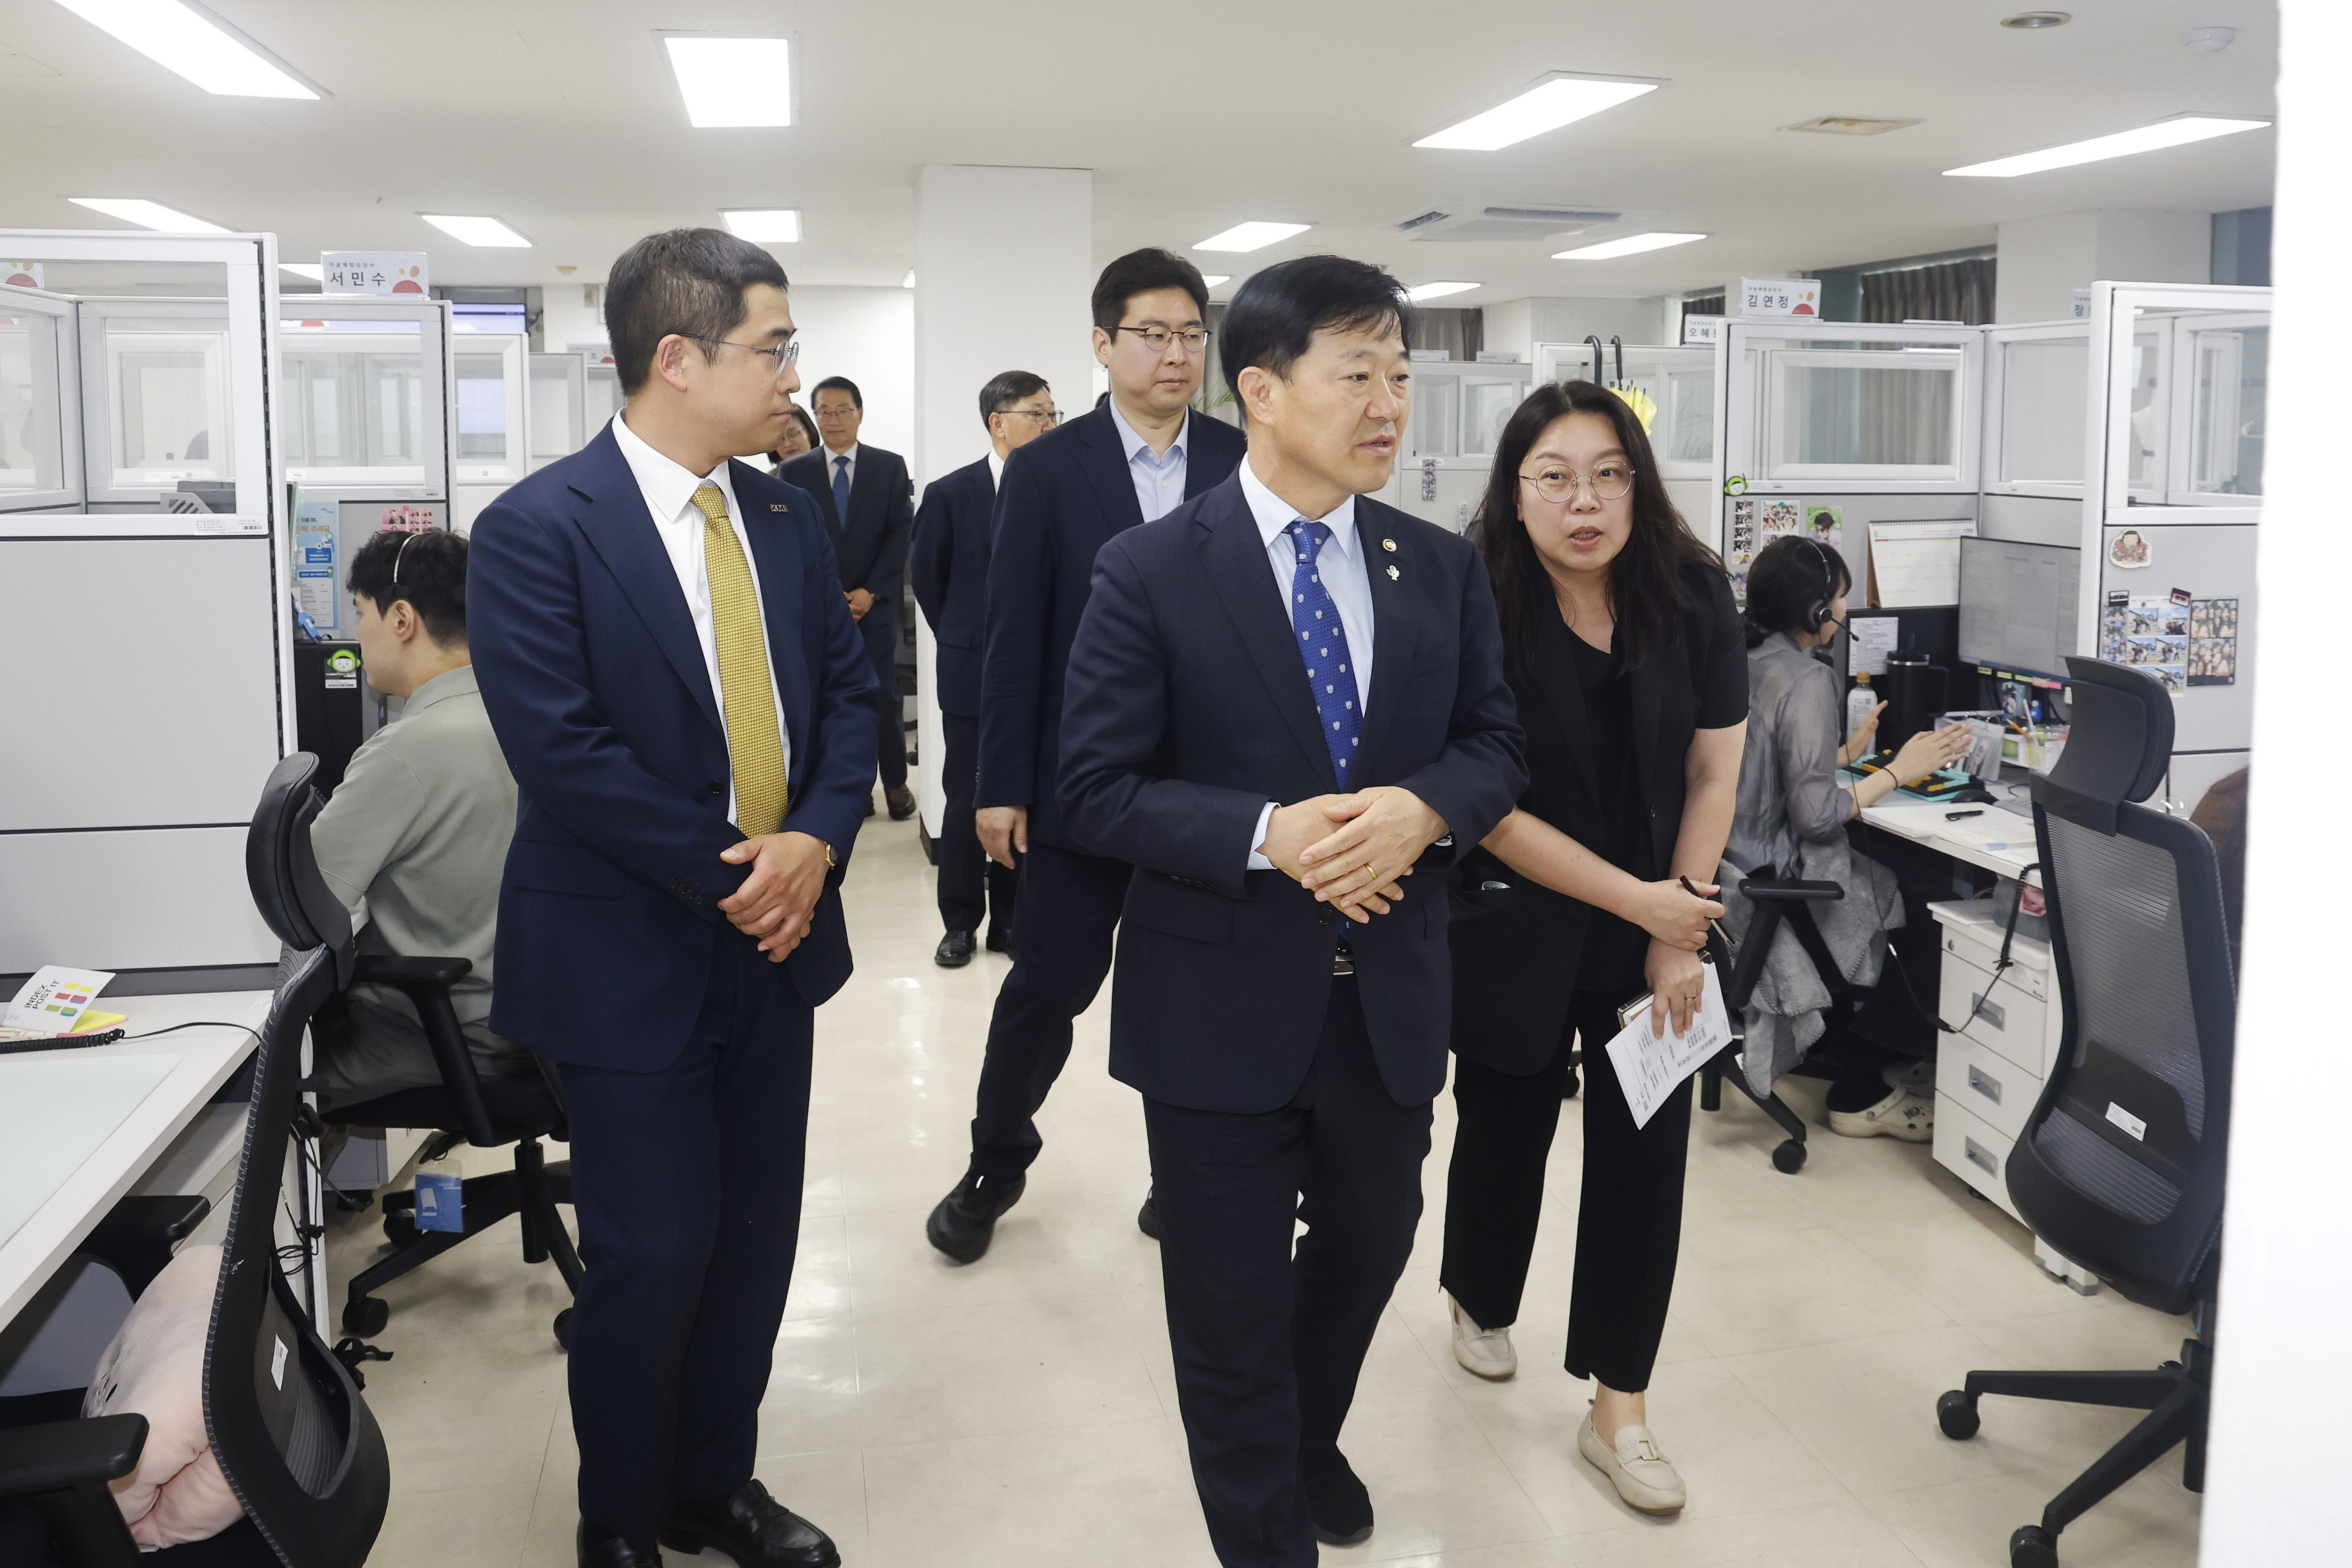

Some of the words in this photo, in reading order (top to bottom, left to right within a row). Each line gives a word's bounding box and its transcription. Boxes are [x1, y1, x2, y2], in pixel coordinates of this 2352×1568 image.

[330, 271, 386, 286] 서민수
[1748, 294, 1788, 309] 김연정
[24, 984, 48, 1008] INDEX
[32, 989, 52, 1009] POST
